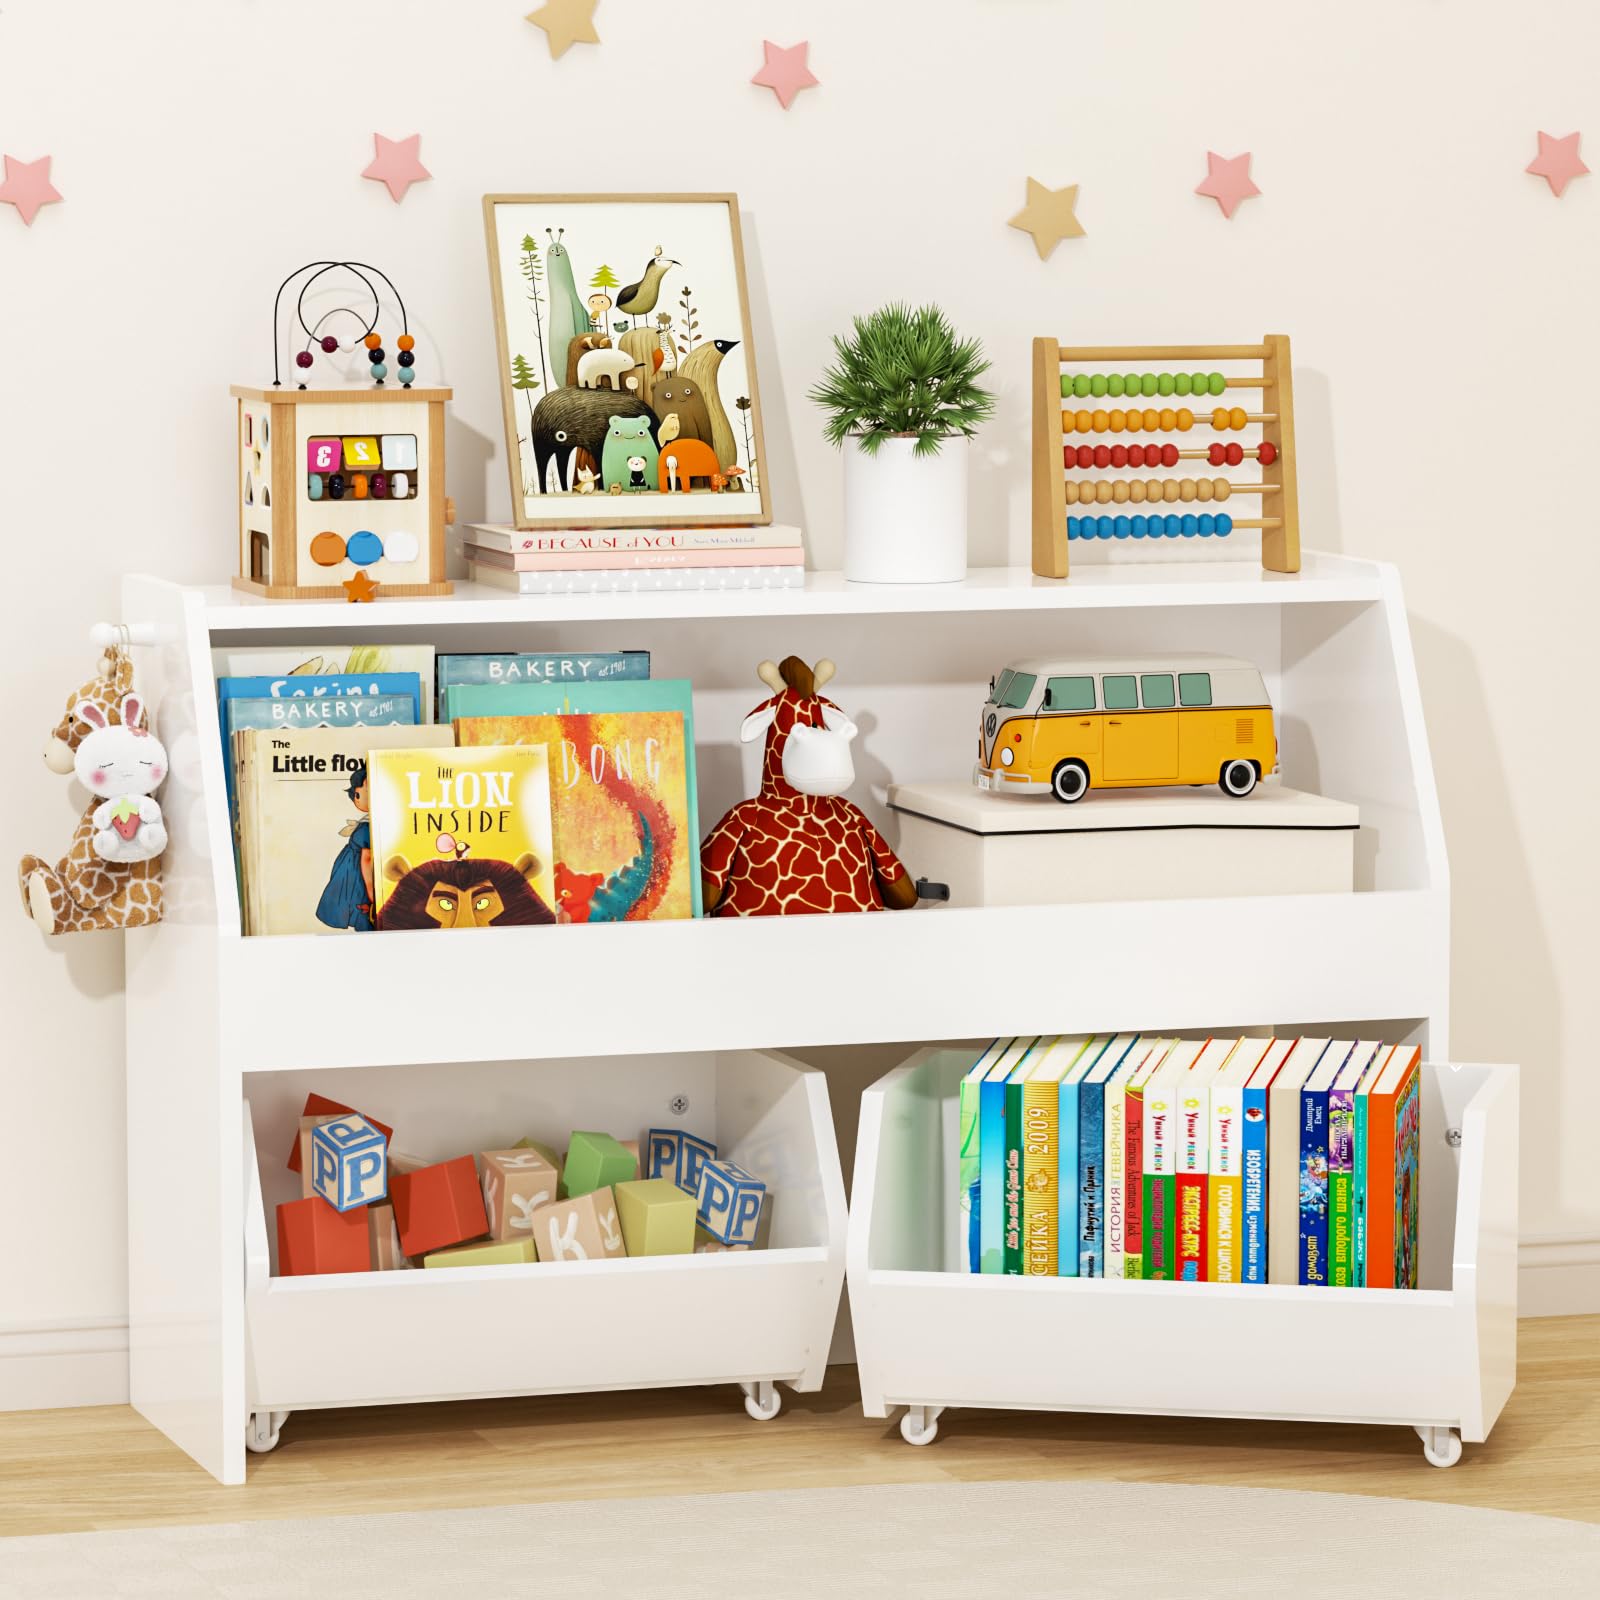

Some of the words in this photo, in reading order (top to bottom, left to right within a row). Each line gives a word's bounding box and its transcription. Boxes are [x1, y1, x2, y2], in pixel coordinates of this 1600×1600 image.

[538, 536, 621, 549] BECAUSE
[643, 535, 684, 548] YOU
[489, 660, 592, 678] BAKERY
[272, 701, 363, 720] BAKERY
[272, 740, 291, 749] The
[272, 754, 327, 773] Little
[406, 771, 514, 809] LION
[437, 766, 454, 779] THE
[413, 810, 511, 834] INSIDE
[1028, 1107, 1049, 1154] 2009
[1128, 1120, 1141, 1135] The
[1305, 1097, 1314, 1132] Дмитрий
[1314, 1105, 1322, 1125] Емец
[328, 1122, 375, 1146] P
[1128, 1138, 1140, 1166] Famous
[315, 1142, 337, 1192] P
[346, 1152, 382, 1201] P
[651, 1137, 676, 1179] P
[697, 1172, 730, 1223] P
[1128, 1169, 1140, 1209] Adventures
[1336, 1178, 1347, 1213] шанса
[732, 1193, 760, 1237] P
[1084, 1202, 1100, 1242] Пафнутий
[1110, 1187, 1121, 1253] ИСТОРИЯ
[1126, 1222, 1140, 1237] Jack
[1182, 1186, 1201, 1258] ЭКСПРЕСС-КУРС
[1217, 1184, 1232, 1239] ГОТОВИМСЯ
[549, 1210, 588, 1261] K
[1246, 1215, 1260, 1263] изменившие
[1335, 1217, 1350, 1263] второго
